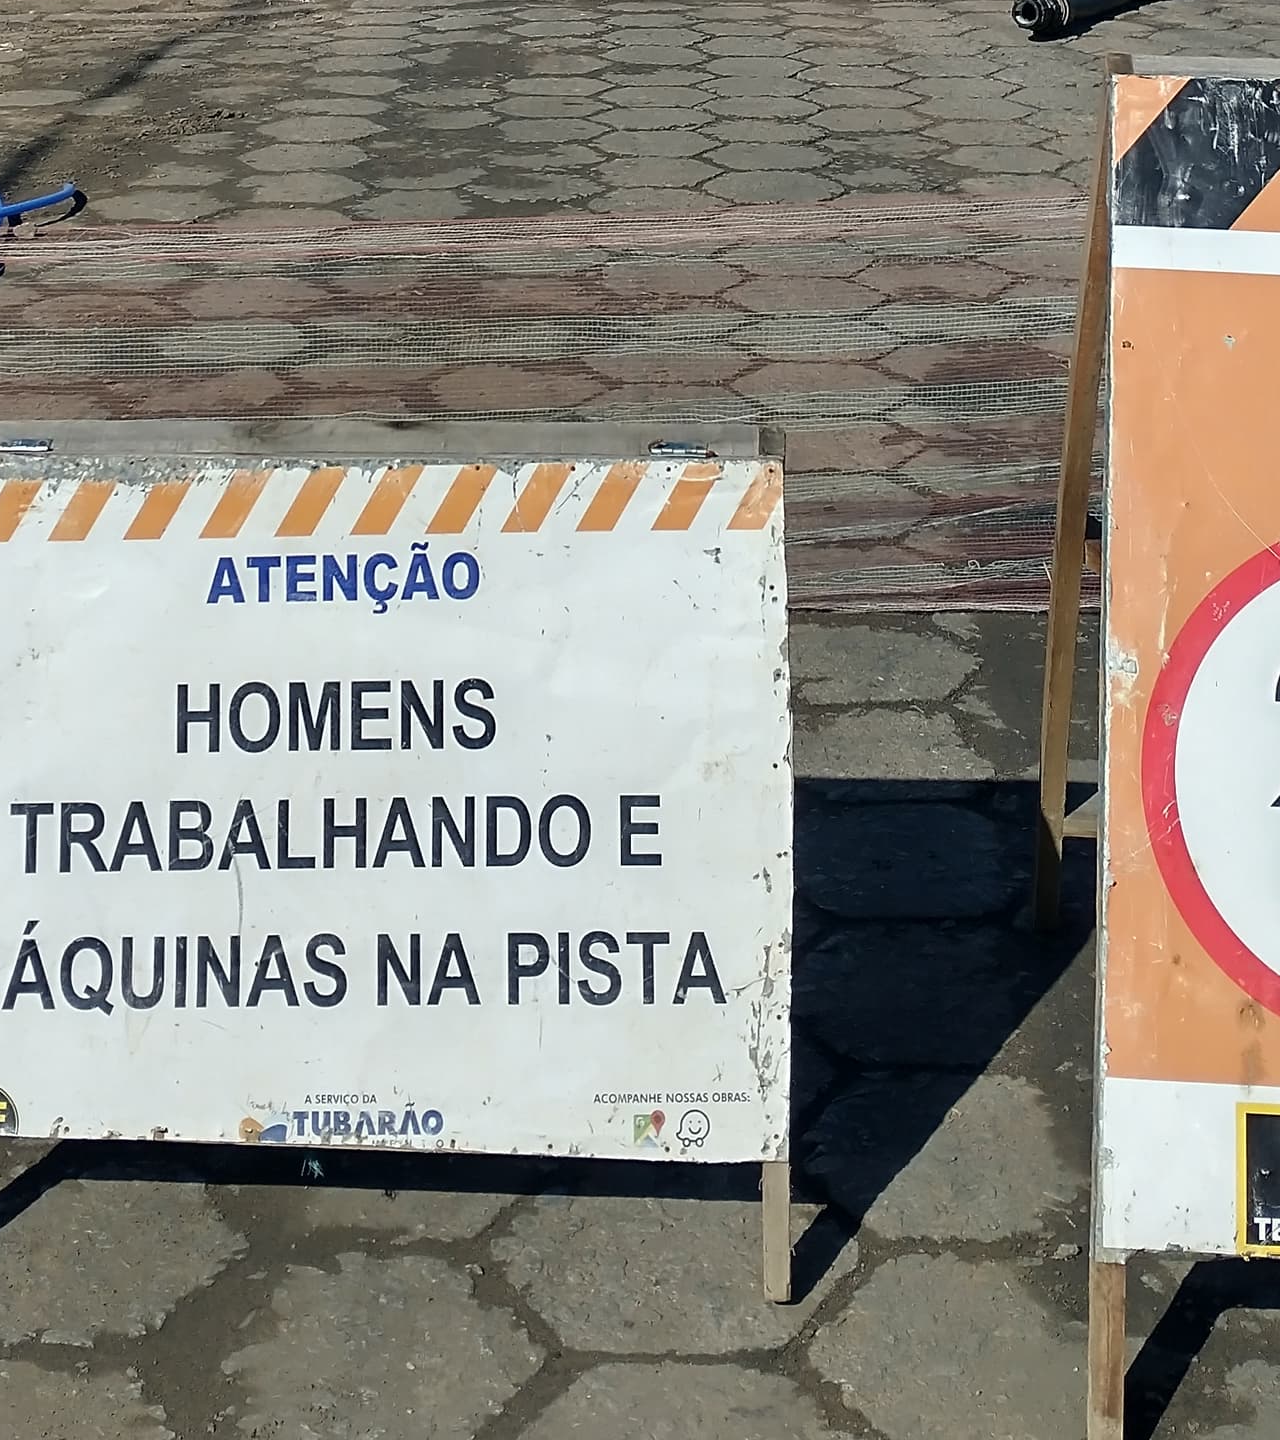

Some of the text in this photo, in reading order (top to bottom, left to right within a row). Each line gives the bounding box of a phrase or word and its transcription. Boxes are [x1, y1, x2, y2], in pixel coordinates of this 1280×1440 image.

[206, 541, 481, 615] ATENÇÃO
[176, 677, 497, 754] HOMENS
[10, 794, 664, 874] TRABALHANDO E
[377, 933, 481, 1006] NA
[507, 930, 728, 1006] PISTA
[292, 1101, 444, 1136] TUBARÃO
[304, 1094, 378, 1106] A SERVIÇO DA
[593, 1091, 751, 1104] ACOMPANHE NOSSAS OBRAS:
